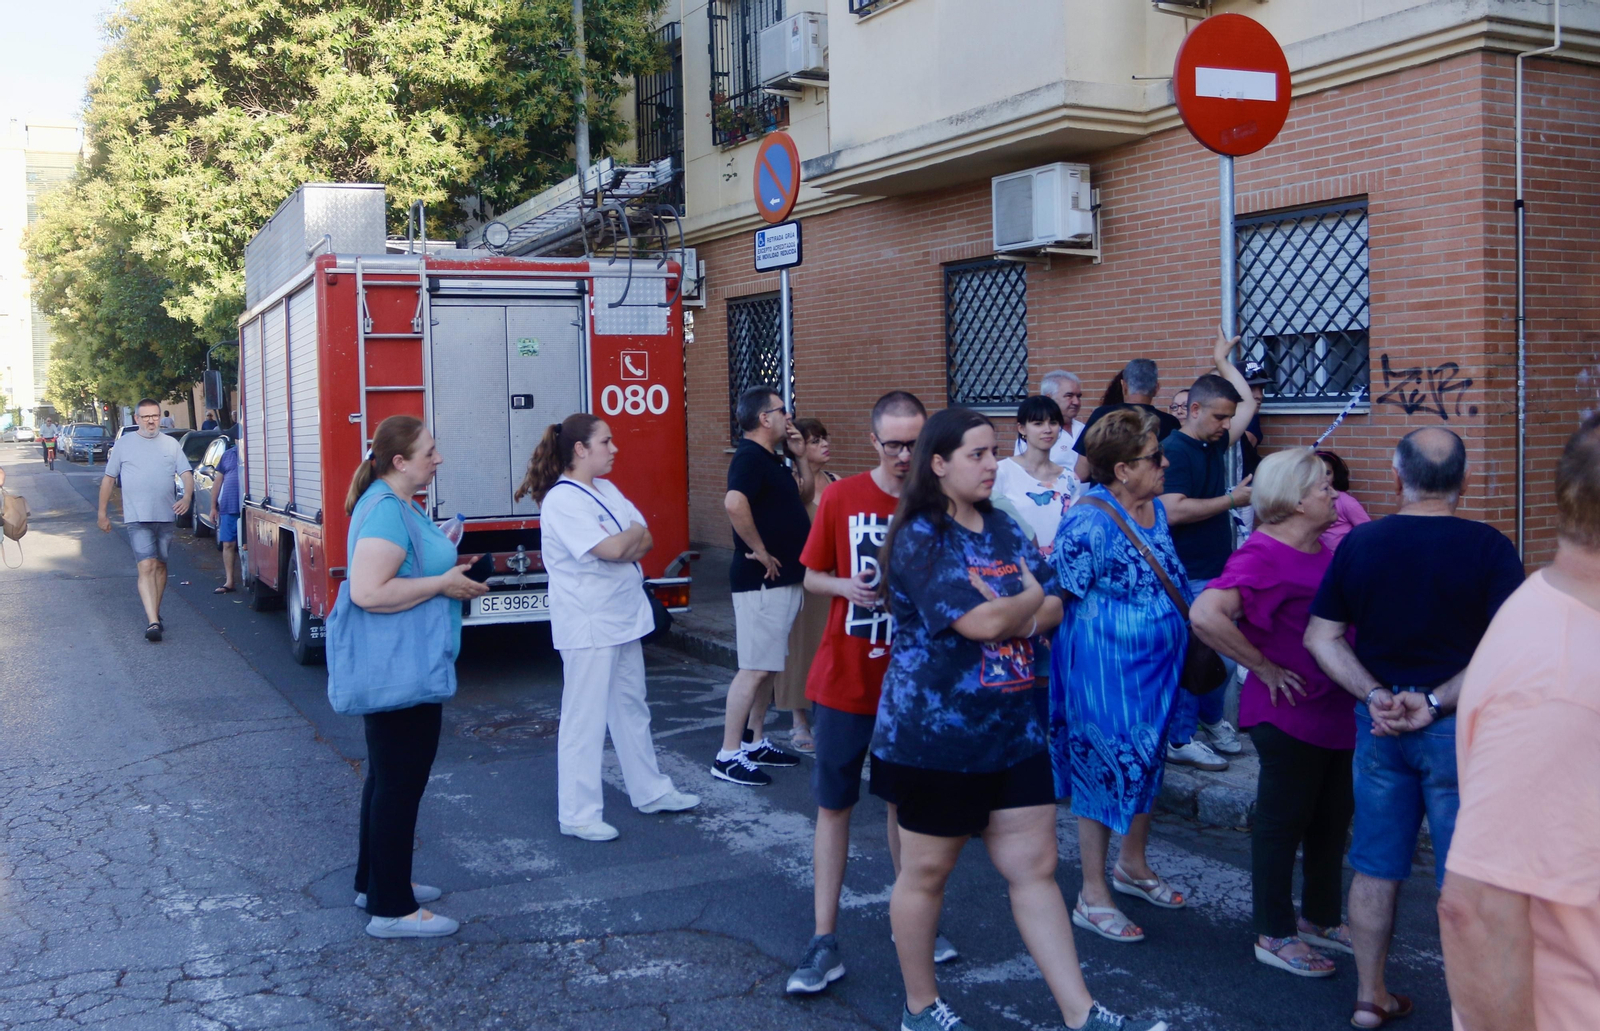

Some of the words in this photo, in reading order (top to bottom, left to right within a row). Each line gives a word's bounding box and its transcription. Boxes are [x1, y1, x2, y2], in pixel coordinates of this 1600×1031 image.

[767, 235, 784, 243] RETIRADA
[758, 246, 772, 254] EXCEPTO
[773, 241, 796, 251] ACREDITADOS
[762, 251, 779, 260] MOVILIDAD
[780, 248, 796, 256] REDUCIDA
[601, 384, 669, 416] 080
